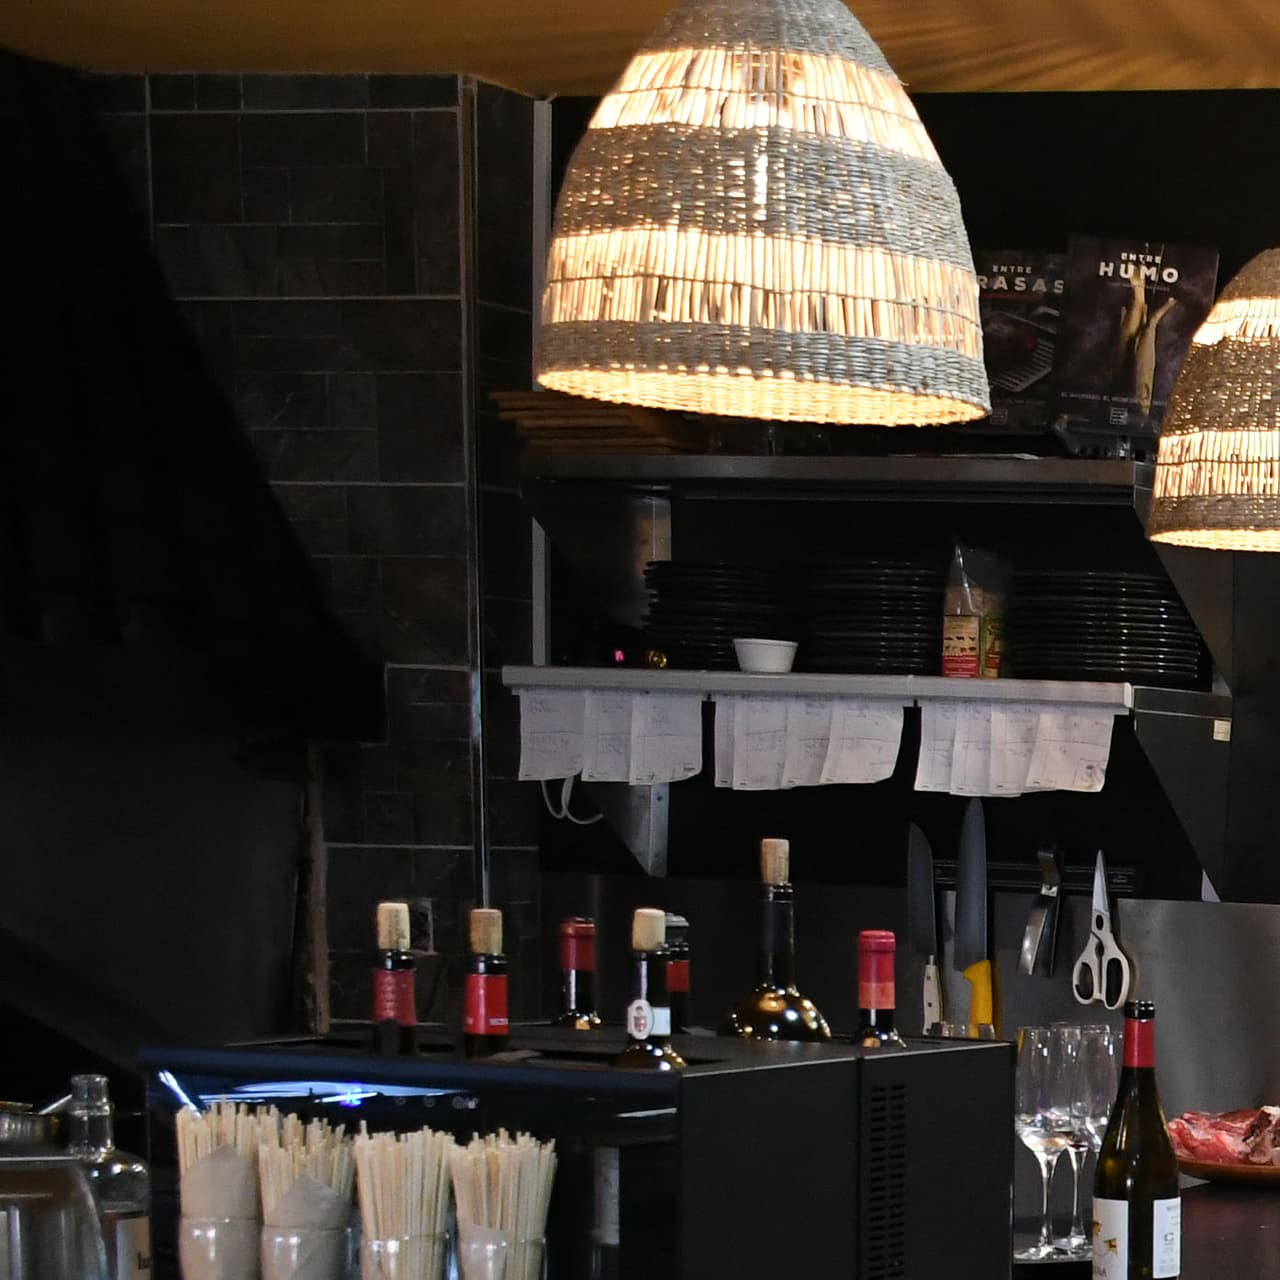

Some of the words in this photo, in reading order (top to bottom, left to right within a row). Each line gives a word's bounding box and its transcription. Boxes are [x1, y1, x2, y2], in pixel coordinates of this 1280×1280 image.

[1120, 252, 1162, 264] ENTRE
[992, 264, 1032, 274] ENTRE
[1099, 261, 1179, 284] HUMO
[977, 274, 1065, 294] RASAS
